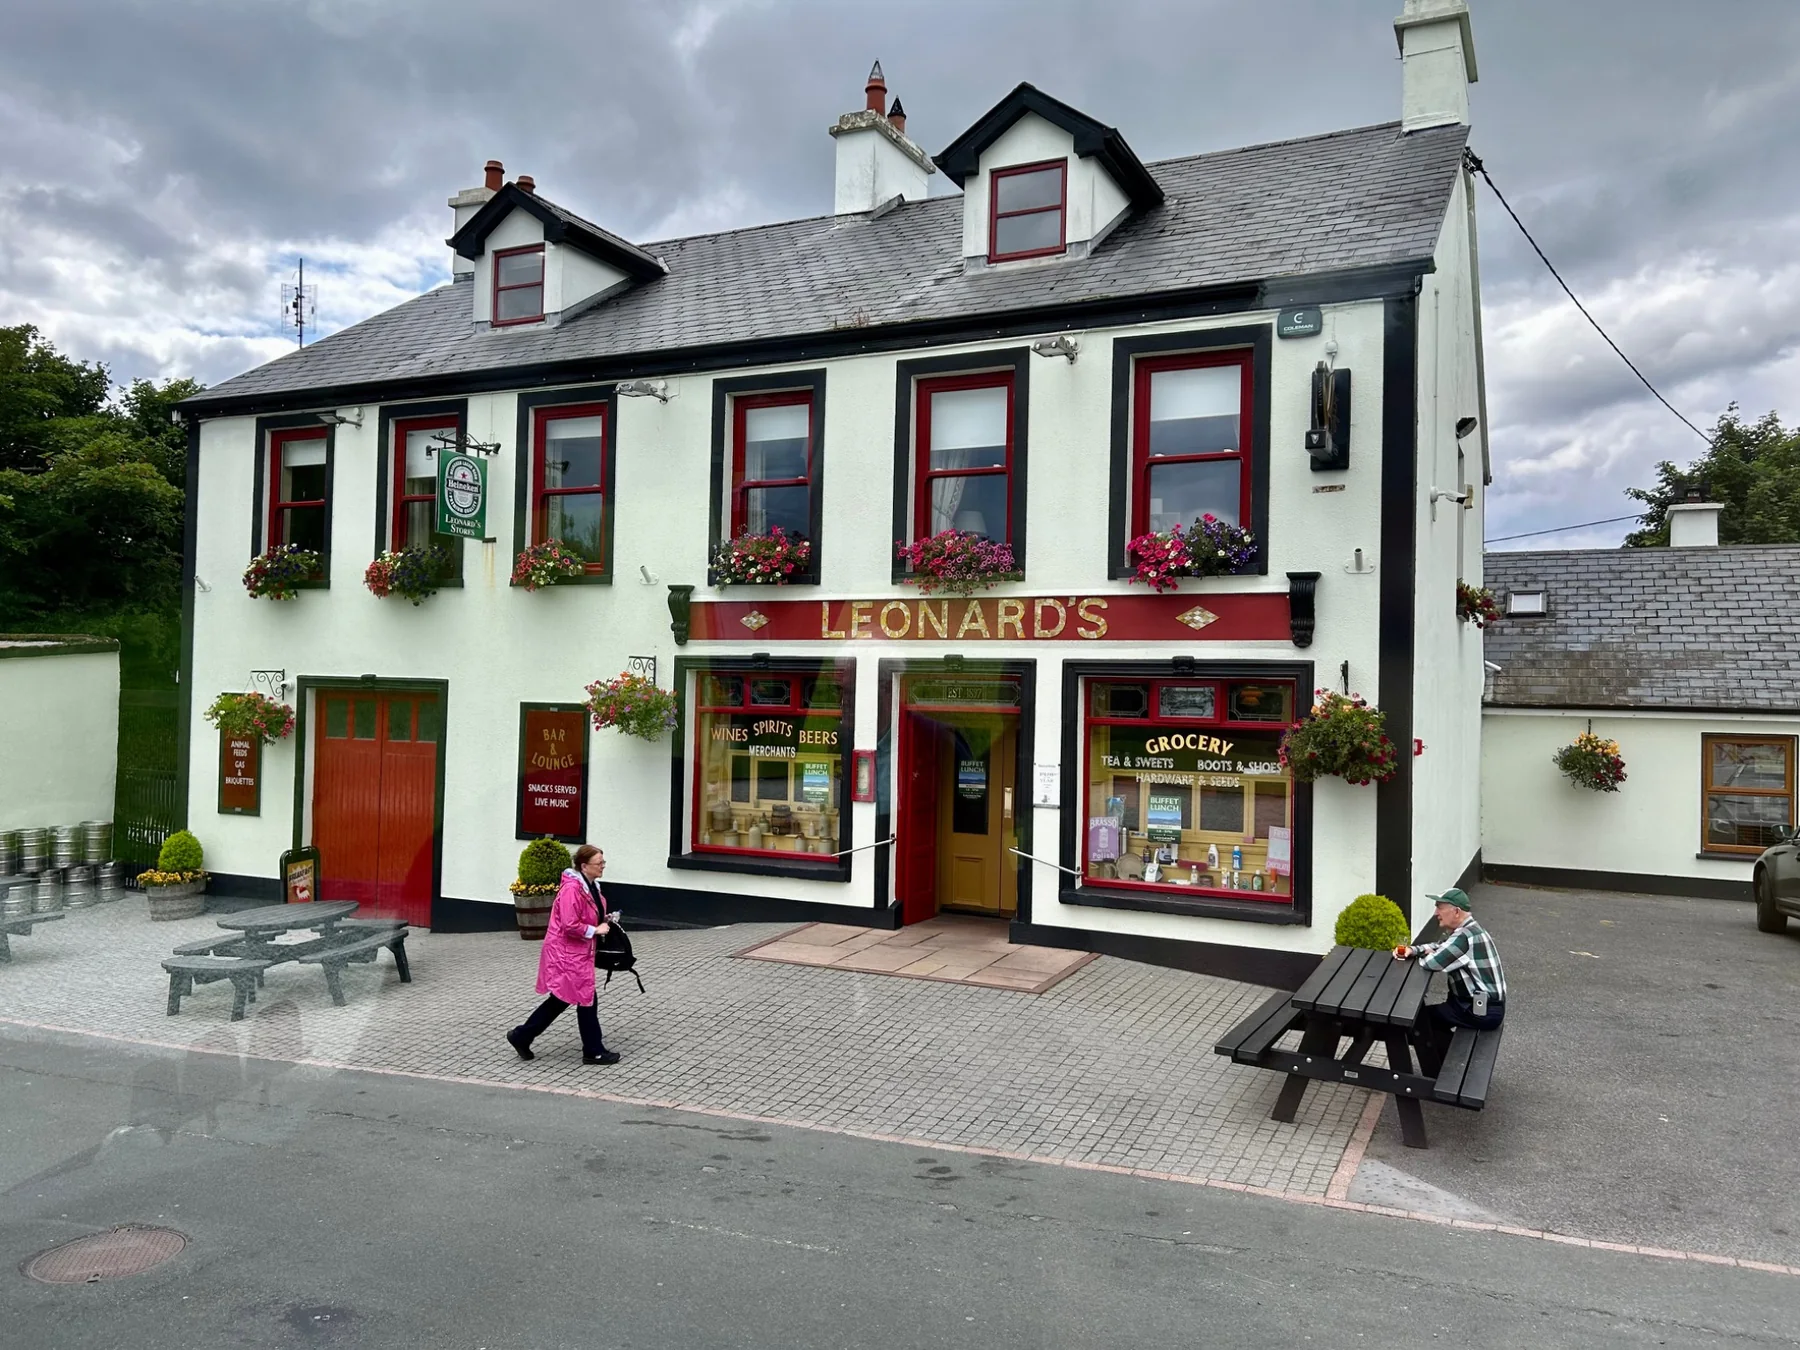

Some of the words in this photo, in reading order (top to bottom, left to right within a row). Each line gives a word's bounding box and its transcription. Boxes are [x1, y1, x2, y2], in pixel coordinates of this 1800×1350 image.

[448, 479, 479, 493] Heineken
[445, 514, 481, 528] LEONARD'S
[451, 523, 475, 536] STORES
[821, 597, 1108, 639] LEONARD'S
[542, 728, 565, 742] BAR
[711, 728, 748, 742] WINES
[753, 720, 793, 737] SPIRITS
[799, 730, 838, 745] BEERS
[231, 741, 250, 749] ANIMAL
[550, 743, 557, 755] &
[748, 745, 796, 758] MERCHANTS
[1145, 733, 1234, 757] GROCERY
[233, 749, 247, 757] FEEDS
[234, 760, 245, 769] GAS
[531, 752, 575, 770] LOUNGE
[1101, 755, 1120, 767] TEA
[1123, 756, 1131, 767] &
[1135, 757, 1174, 769] SWEETS
[1197, 759, 1232, 771] BOOTS
[1236, 761, 1245, 772] &
[1248, 761, 1282, 773] SHOES
[225, 777, 254, 786] BRIQUETTES
[1136, 772, 1194, 786] HARDWARE
[1198, 776, 1206, 786] &
[1211, 776, 1240, 788] SEEDS
[528, 784, 553, 792] SNACKS
[554, 785, 577, 794] SERVED
[534, 797, 548, 806] LIVE
[549, 798, 569, 808] MUSIC
[1090, 818, 1117, 829] BRASSO
